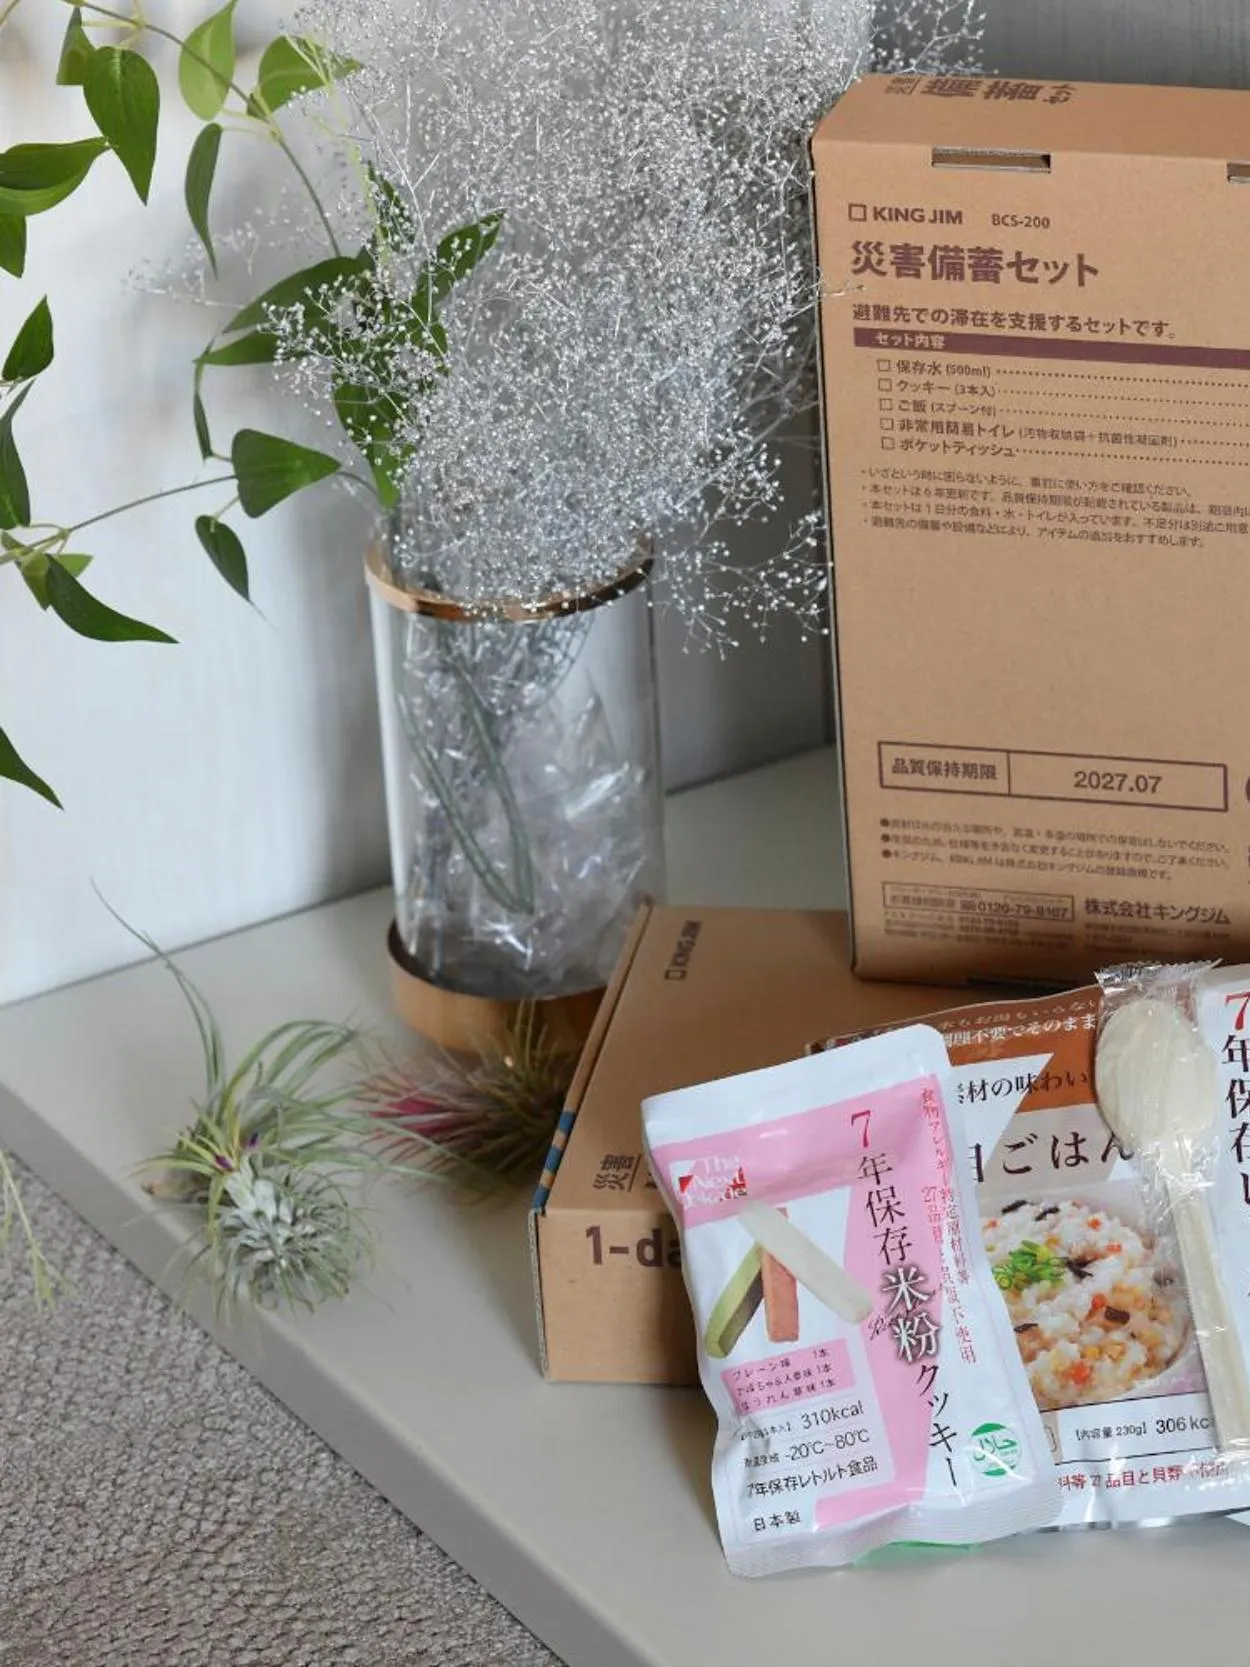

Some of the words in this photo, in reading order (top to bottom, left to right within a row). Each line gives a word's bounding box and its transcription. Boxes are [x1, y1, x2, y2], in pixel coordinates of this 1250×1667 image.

[873, 206, 925, 222] KING
[929, 209, 963, 225] JIM
[991, 213, 1051, 229] BCS-200
[850, 240, 1100, 287] 災害備蓄セット
[852, 303, 1176, 339] 避難先での滞在を支援するセットです。
[875, 332, 946, 350] セット内容
[896, 360, 942, 376] 保存水
[945, 362, 992, 378] (500ml)
[896, 379, 951, 396] クッキー
[898, 398, 928, 414] ご飯
[899, 418, 1015, 439] 非常用簡易トイレ
[899, 439, 1016, 458] ポケットティッシュ
[891, 758, 998, 780] 品質保持期限
[1073, 771, 1163, 793] 2027.07
[1084, 897, 1231, 925] 株式会社キングジム
[958, 1071, 1088, 1104] 材の味わい
[967, 1131, 1135, 1183] ごはん
[800, 1400, 865, 1430] 310kcal
[1155, 1416, 1187, 1435] 306
[1190, 1415, 1216, 1431] kc
[747, 1455, 878, 1498] 7年保存レトルト食品
[753, 1510, 803, 1532] 日本製
